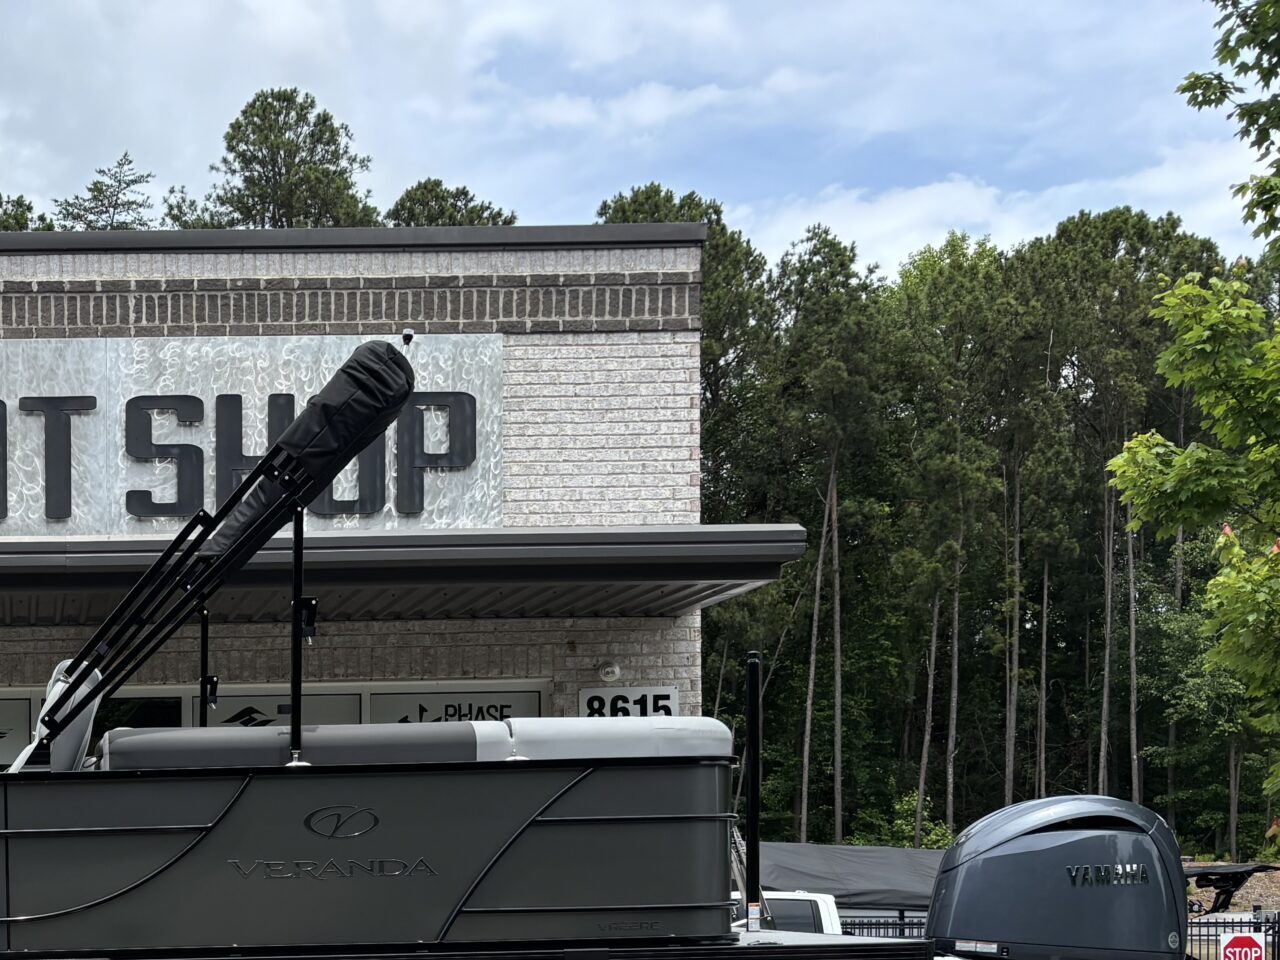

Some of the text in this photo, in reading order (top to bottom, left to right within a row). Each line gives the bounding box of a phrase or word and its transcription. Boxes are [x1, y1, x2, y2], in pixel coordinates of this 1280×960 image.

[445, 703, 512, 722] PHASE
[586, 694, 672, 717] 8615
[227, 857, 439, 880] VERANDA
[1066, 863, 1149, 887] YAMAHA
